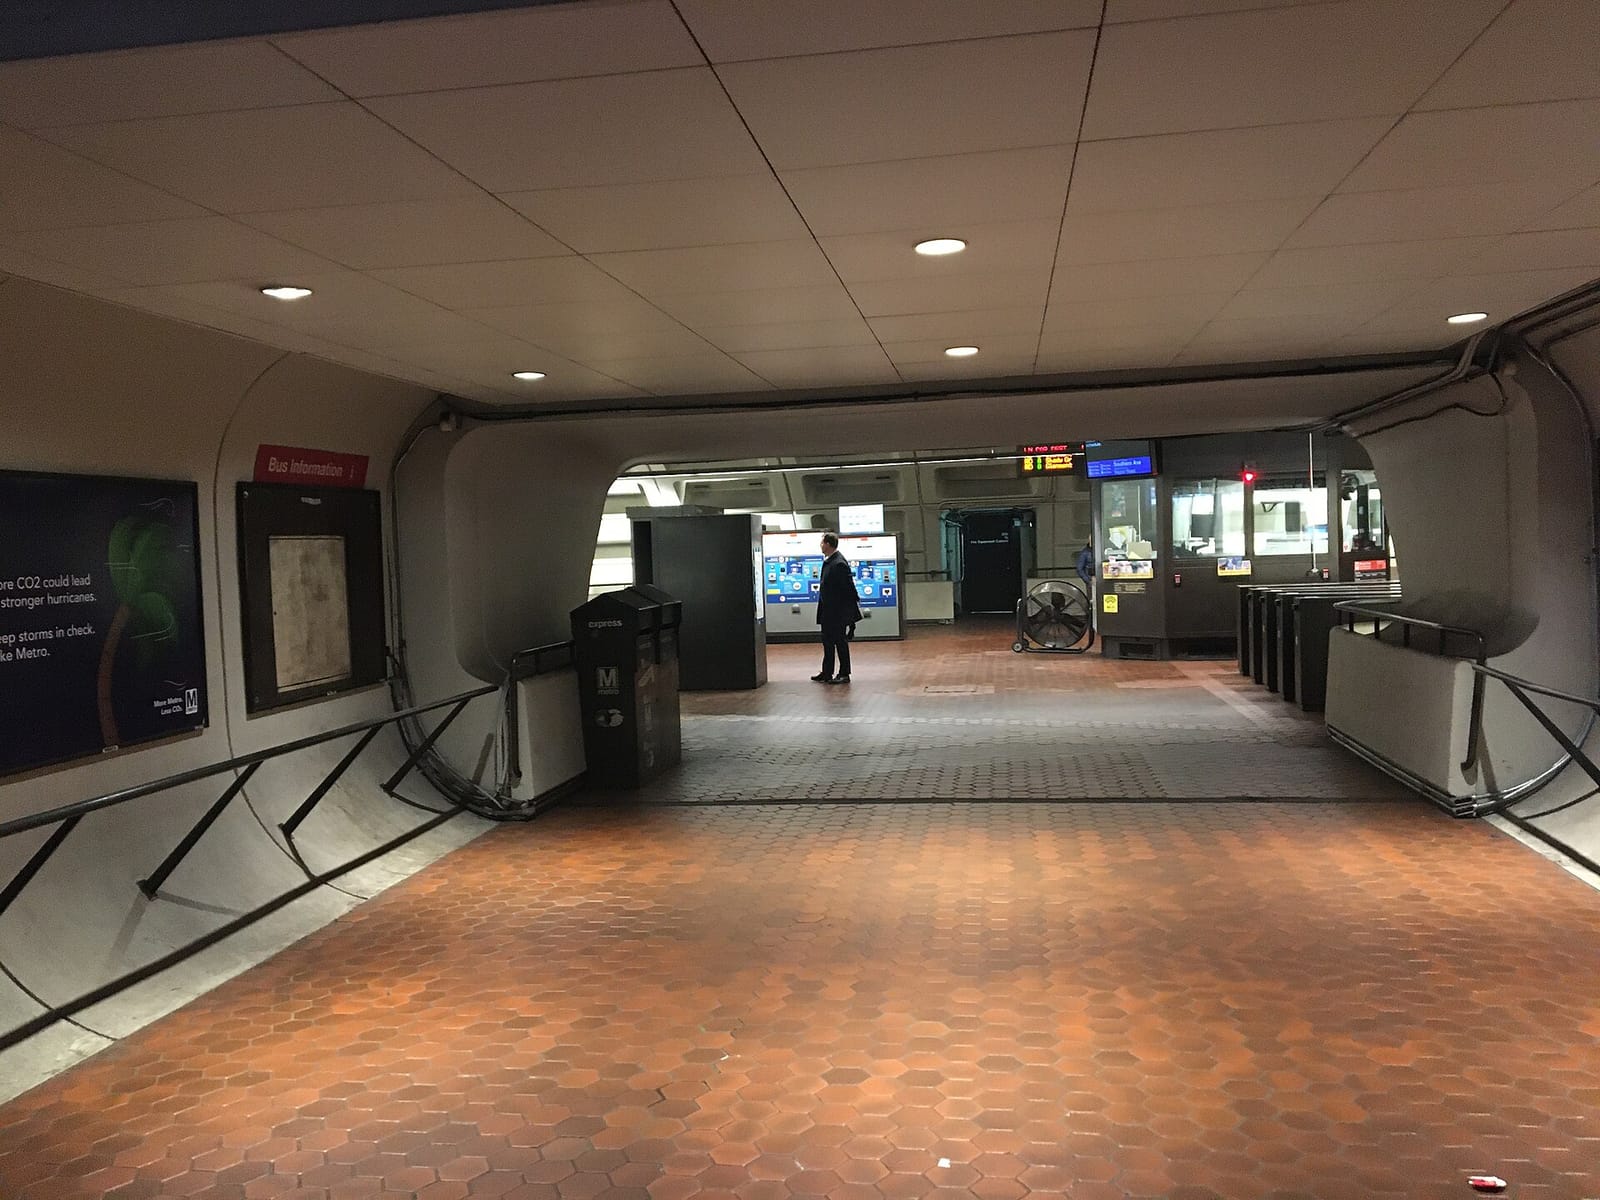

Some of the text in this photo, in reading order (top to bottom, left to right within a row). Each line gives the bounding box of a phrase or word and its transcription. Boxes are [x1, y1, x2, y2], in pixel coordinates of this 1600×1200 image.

[268, 457, 343, 477] Bus Information
[16, 576, 41, 590] CO2
[42, 573, 70, 588] could
[71, 572, 91, 586] lead
[0, 592, 97, 610] stronger hurricanes.
[588, 619, 622, 629] express
[0, 621, 96, 647] ep storms in check.
[15, 646, 51, 660] Metro.
[598, 668, 616, 687] M
